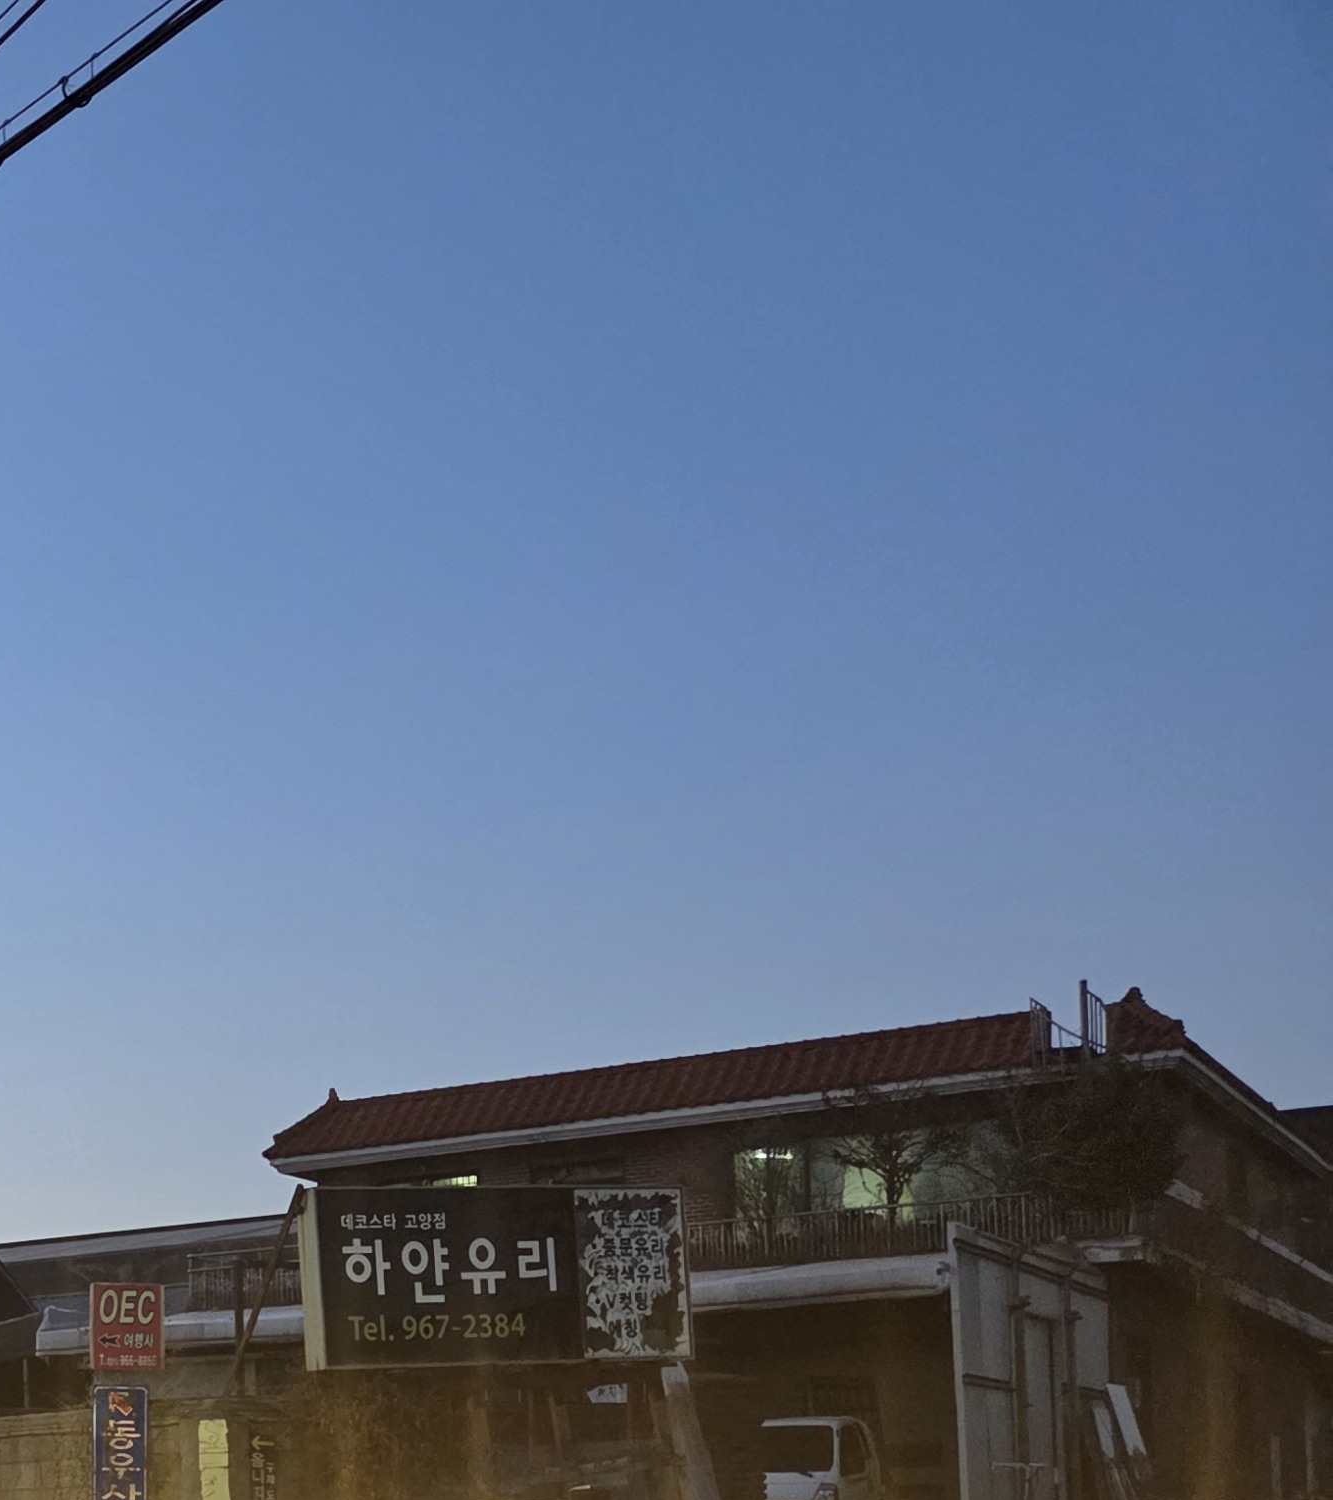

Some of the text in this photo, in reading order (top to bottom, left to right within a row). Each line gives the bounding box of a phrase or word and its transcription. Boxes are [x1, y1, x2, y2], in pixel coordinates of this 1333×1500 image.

[340, 1212, 447, 1230] 데코스타 고양점
[341, 1236, 559, 1304] 하얀유리
[99, 1289, 156, 1325] OEC
[123, 1332, 154, 1349] 여행사
[348, 1313, 527, 1341] Tel. 967-2384
